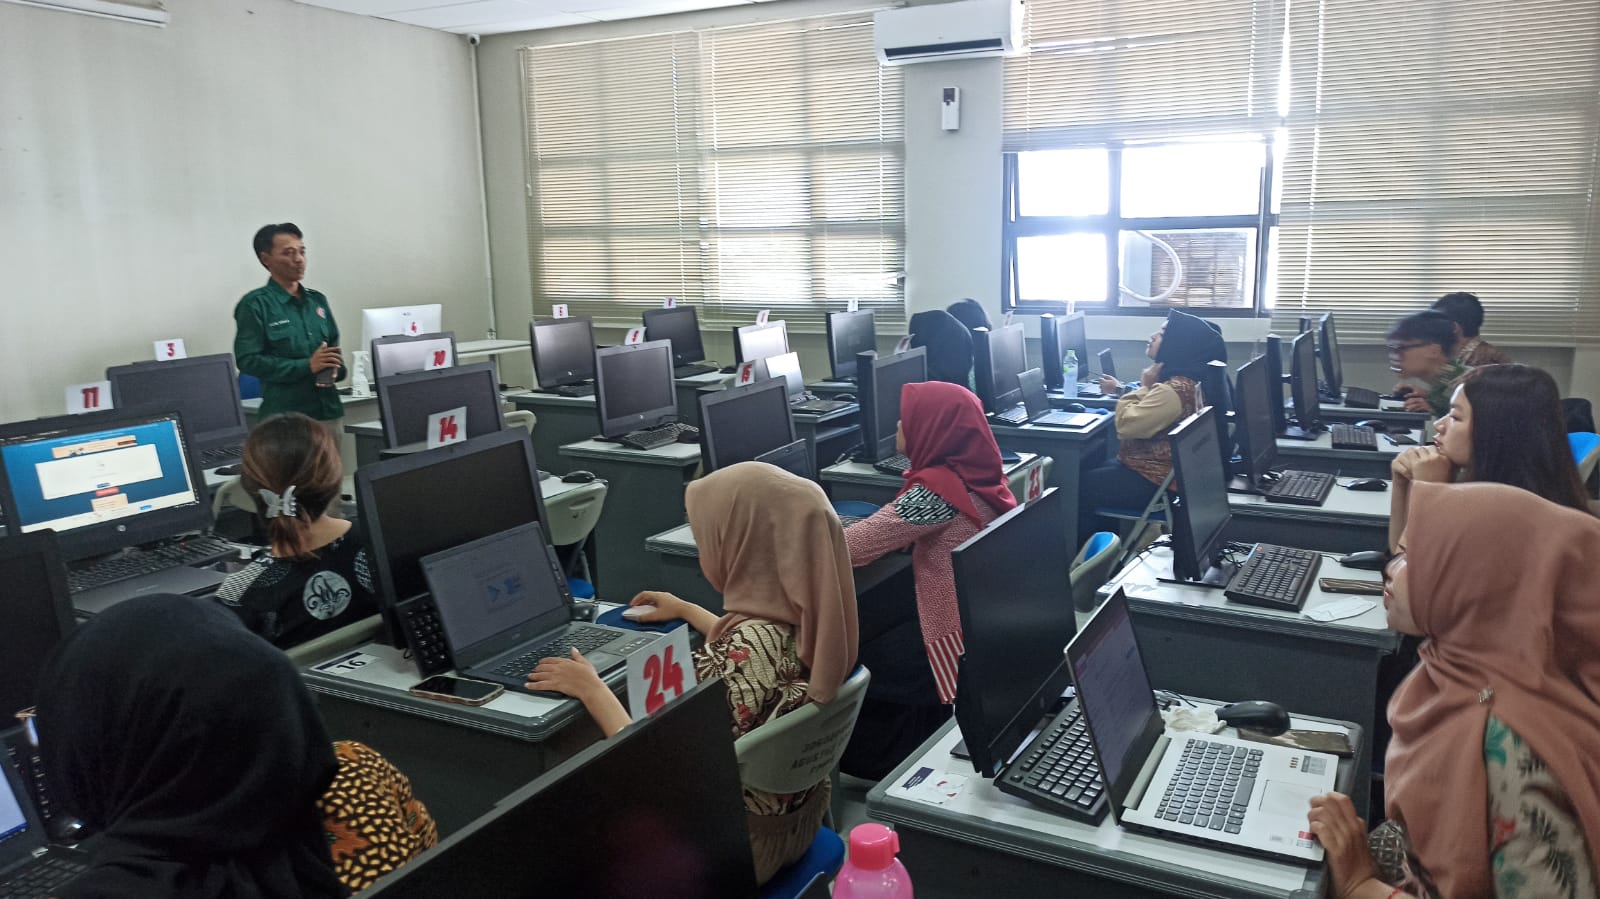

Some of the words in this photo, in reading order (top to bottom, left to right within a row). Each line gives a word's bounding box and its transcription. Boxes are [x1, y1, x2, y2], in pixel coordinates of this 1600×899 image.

[167, 342, 176, 357] 3
[82, 387, 99, 408] 11
[439, 415, 458, 442] 14
[335, 660, 367, 670] 16
[643, 644, 684, 714] 24
